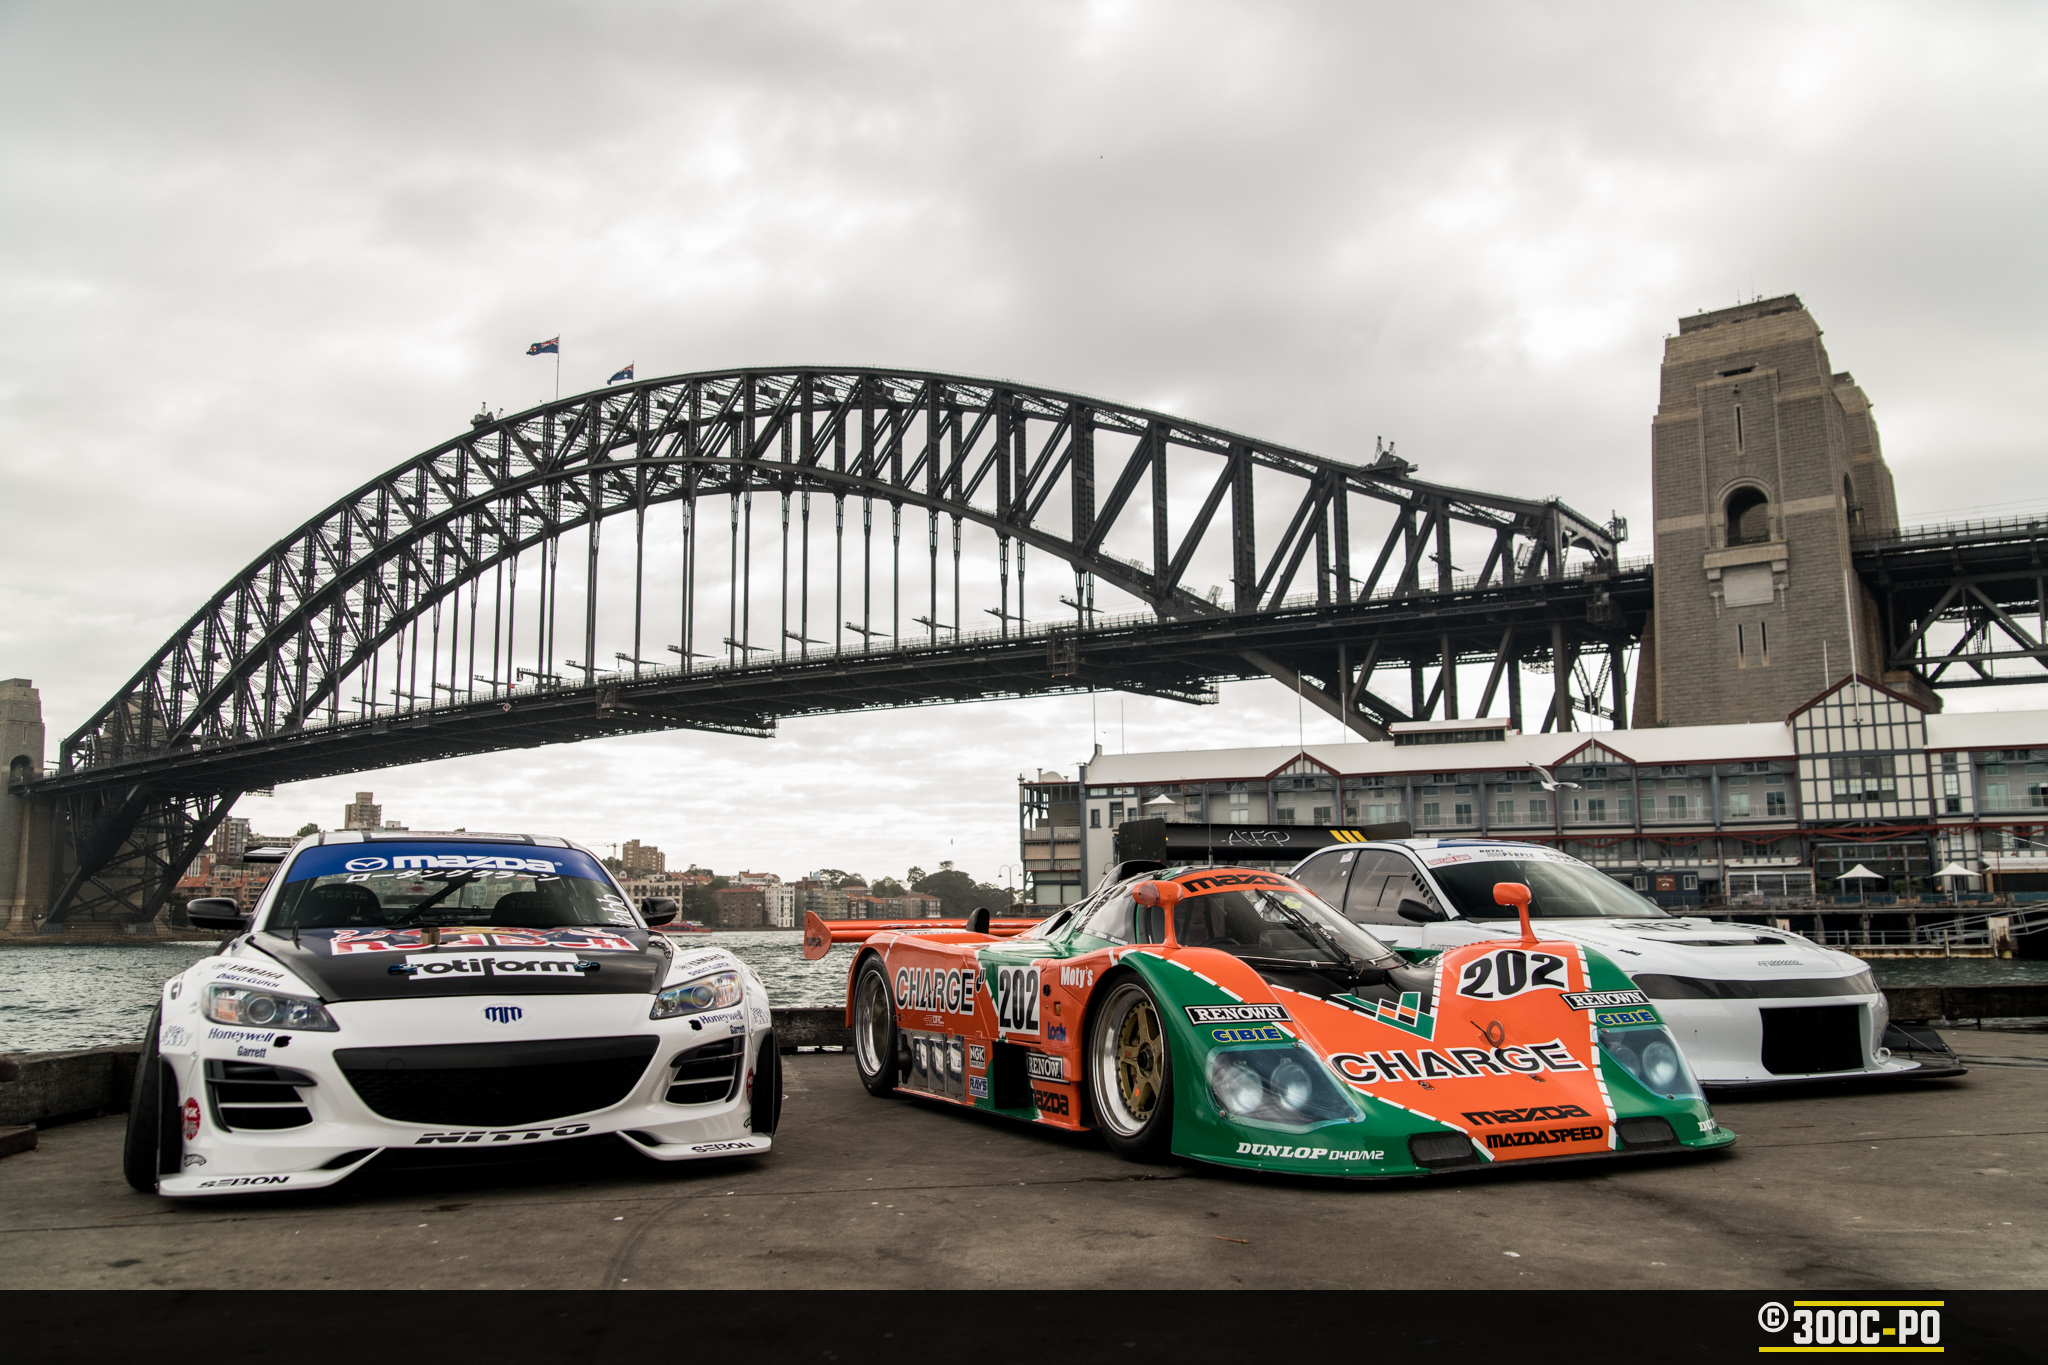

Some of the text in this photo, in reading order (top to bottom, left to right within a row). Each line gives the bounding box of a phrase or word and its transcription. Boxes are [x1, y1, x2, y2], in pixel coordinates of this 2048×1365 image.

[392, 855, 555, 873] mazda
[317, 889, 369, 901] TAKATA
[216, 972, 280, 988] DIRECT CLUTCH
[228, 964, 284, 980] YAMAHA
[1060, 966, 1094, 989] Moty's
[1459, 950, 1565, 999] 202
[895, 966, 976, 1016] CHARGE
[999, 968, 1039, 1031] 202
[1568, 993, 1646, 1007] RENOWN
[698, 1010, 743, 1025] Honeywell
[1193, 1005, 1283, 1021] RENOWN
[207, 1028, 276, 1043] Honeywell
[729, 1024, 746, 1035] Garrett
[236, 1045, 267, 1059] Garrett
[969, 1046, 985, 1062] NGK
[1327, 1038, 1588, 1085] CHARGE
[969, 1078, 987, 1092] RAYS
[1461, 1105, 1592, 1126] mazda
[414, 1123, 591, 1145] NITTO
[1486, 1126, 1604, 1149] MAZDASPEED
[1236, 1142, 1385, 1161] DUNLOP D40/M2
